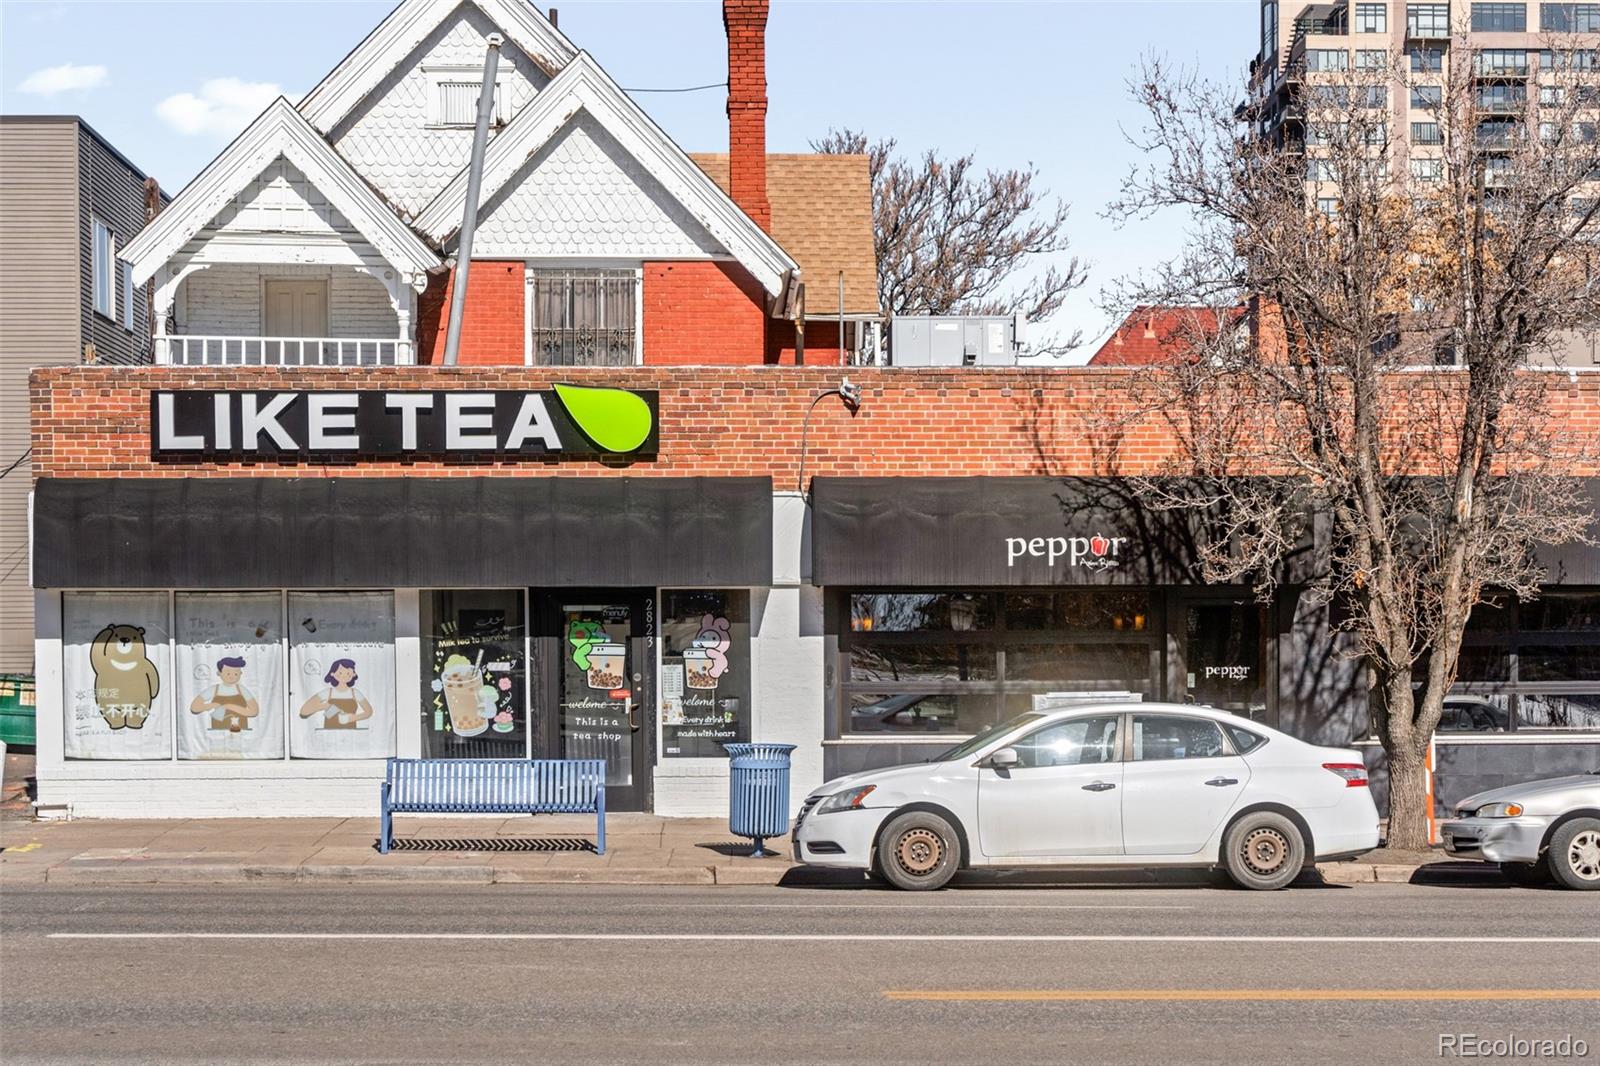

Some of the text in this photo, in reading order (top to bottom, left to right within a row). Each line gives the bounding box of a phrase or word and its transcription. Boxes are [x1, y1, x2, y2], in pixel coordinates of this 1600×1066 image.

[158, 393, 562, 450] LIKE TEA
[645, 599, 654, 648] 2823
[438, 639, 456, 648] Milk
[456, 638, 471, 646] tea
[480, 633, 510, 644] survive
[575, 717, 597, 726] This
[600, 717, 609, 726] is
[683, 716, 704, 724] Every
[704, 715, 724, 724] drink
[572, 731, 622, 742] tea shop
[677, 729, 737, 738] made with heart
